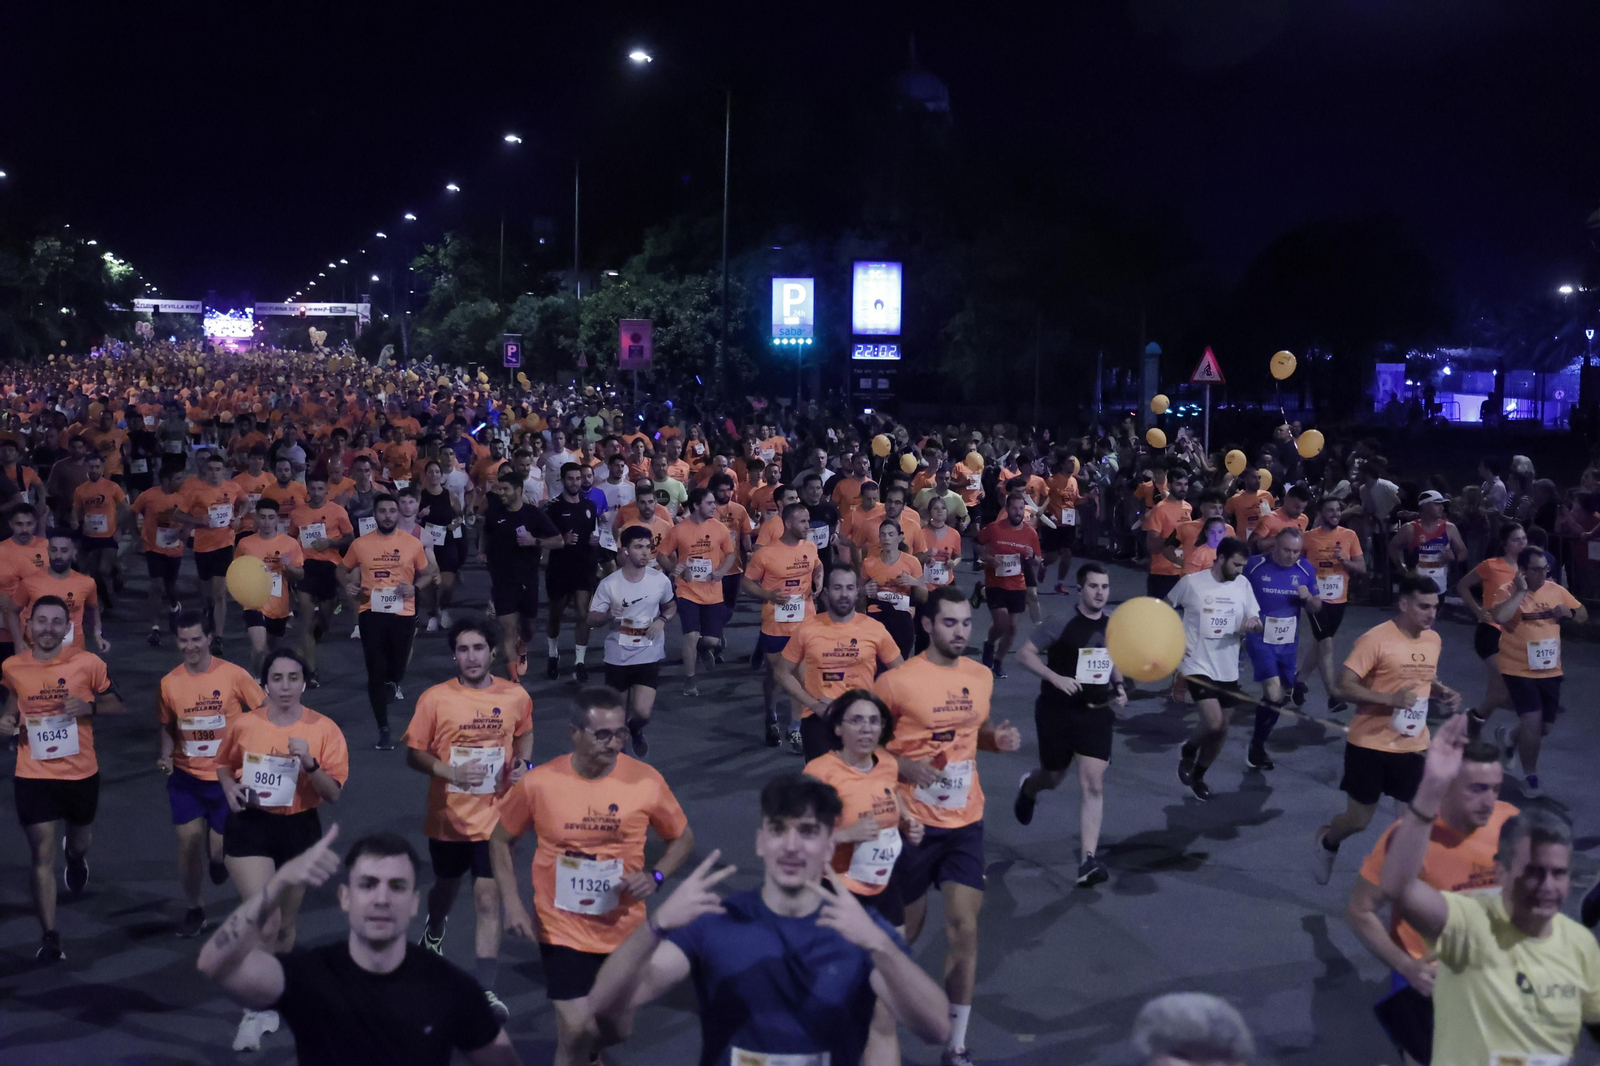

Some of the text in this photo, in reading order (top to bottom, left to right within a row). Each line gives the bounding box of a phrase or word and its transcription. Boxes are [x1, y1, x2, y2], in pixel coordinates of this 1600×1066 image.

[783, 283, 806, 316] P
[779, 326, 803, 335] saba
[507, 345, 517, 356] P
[854, 344, 898, 358] 22:02
[781, 603, 801, 611] 20261
[1210, 617, 1228, 626] 7095
[1274, 626, 1290, 634] 7047
[1087, 659, 1110, 669] 11359
[37, 728, 69, 742] 16343
[192, 730, 215, 740] 1398
[254, 771, 282, 786] 9801
[582, 816, 622, 824] NOCTURNA
[564, 823, 599, 831] SEVILLA
[570, 876, 611, 892] 11326
